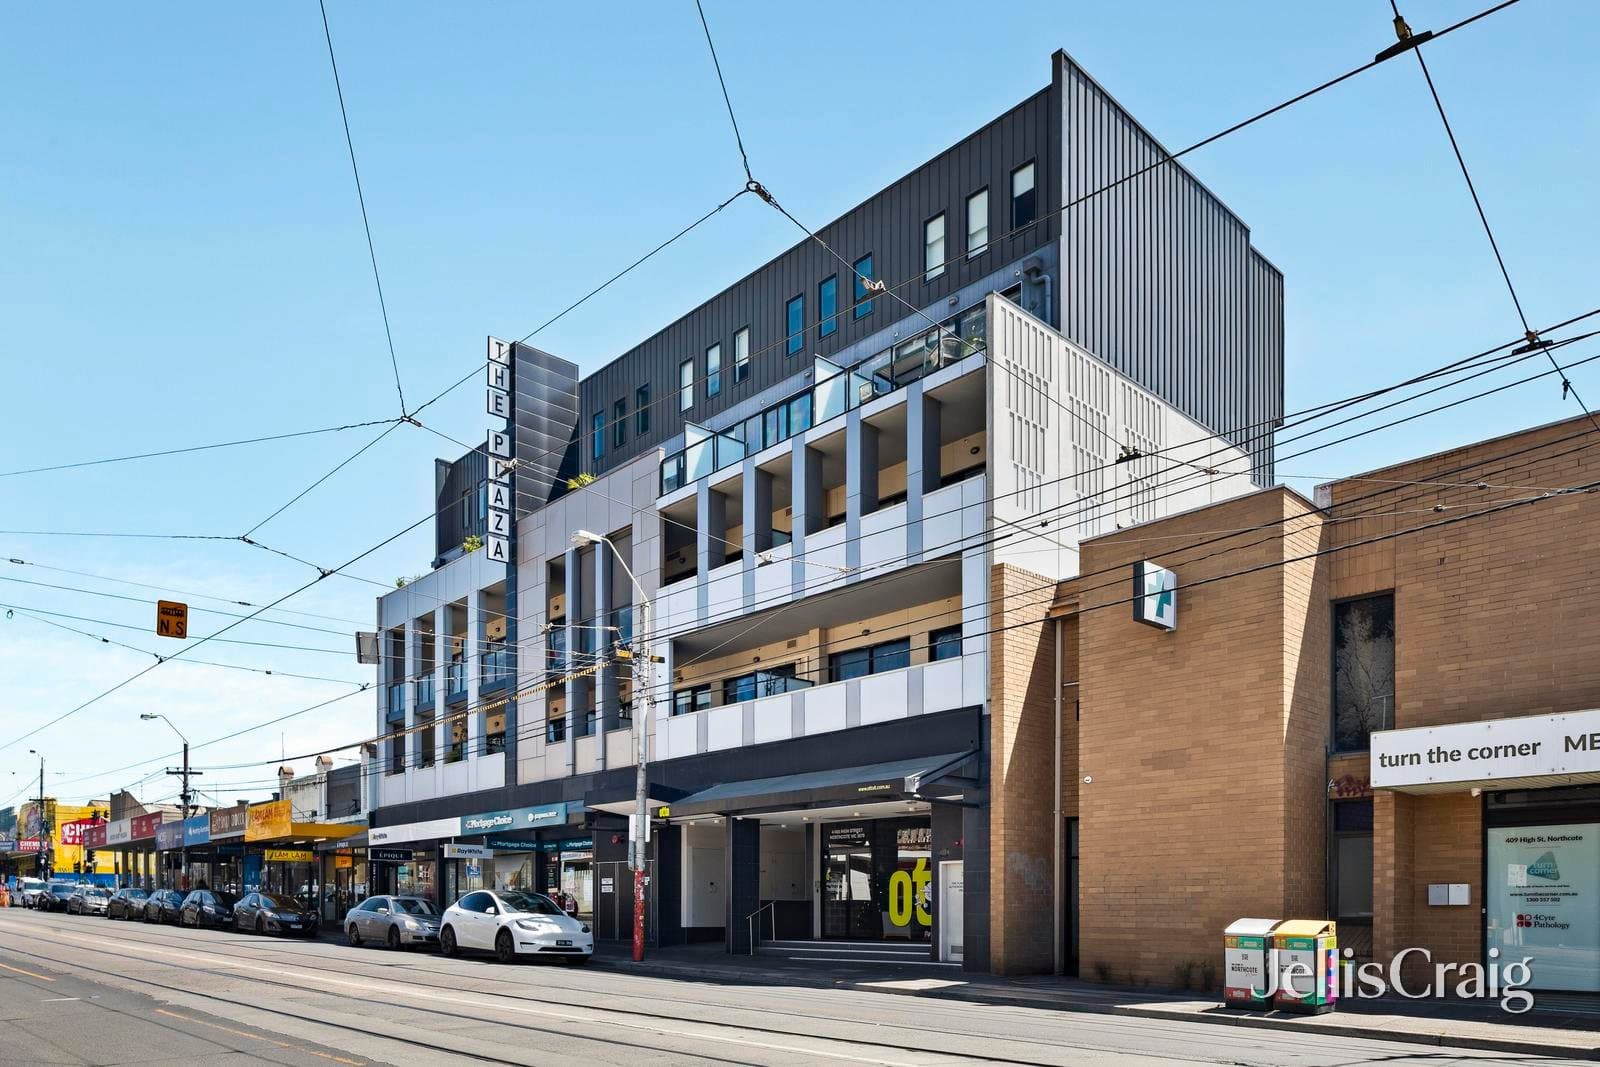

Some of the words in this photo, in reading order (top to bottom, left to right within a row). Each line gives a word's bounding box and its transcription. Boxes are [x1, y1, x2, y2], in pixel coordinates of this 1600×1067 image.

[494, 341, 505, 414] THE
[160, 619, 170, 634] N
[176, 621, 185, 636] S
[1379, 752, 1421, 768] turn
[1427, 746, 1462, 764] the
[1467, 741, 1541, 761] corner
[471, 818, 495, 829] Mortgage
[494, 815, 514, 825] Choice
[1533, 914, 1556, 922] 4Cyte
[1533, 921, 1570, 930] Pathology
